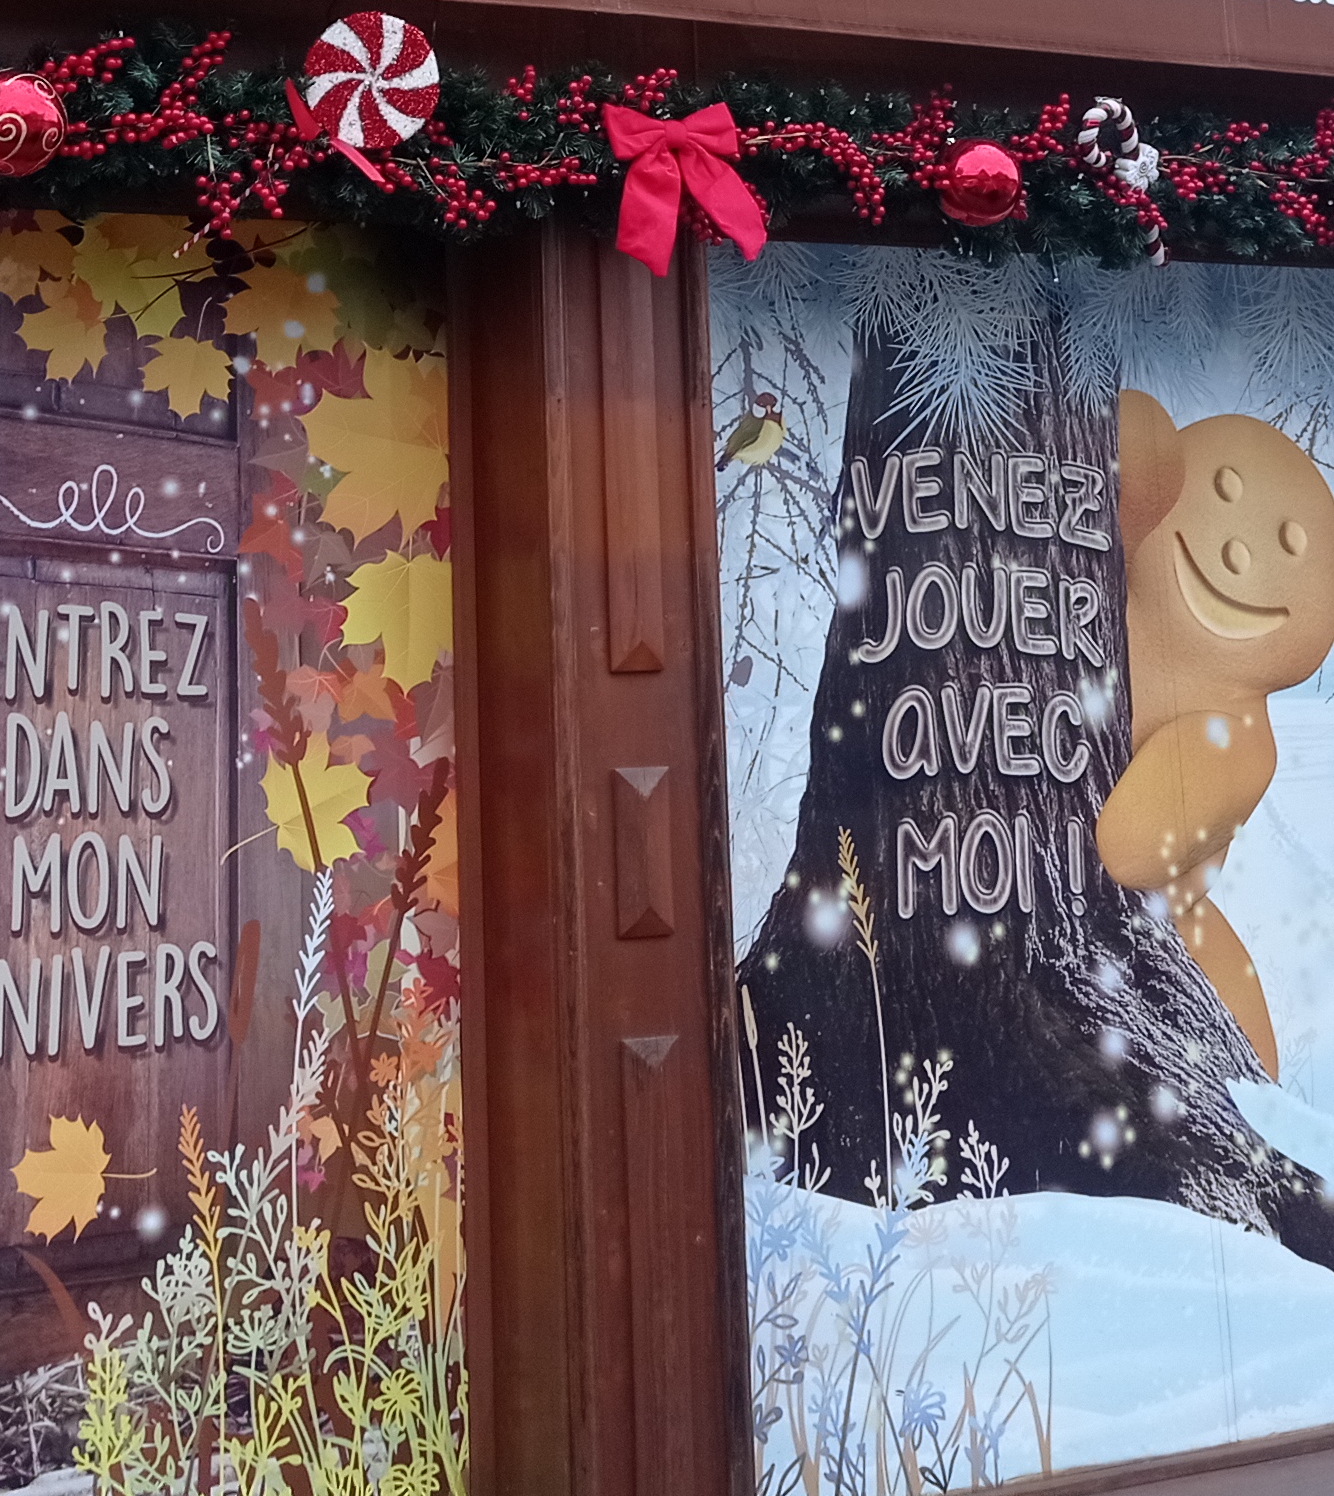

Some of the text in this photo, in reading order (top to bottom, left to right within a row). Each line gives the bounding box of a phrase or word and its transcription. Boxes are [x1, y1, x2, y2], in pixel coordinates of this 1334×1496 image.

[850, 447, 1113, 553] VENEZ
[857, 562, 1106, 668] JOUER
[4, 711, 172, 820] DANS
[10, 831, 164, 936] MON
